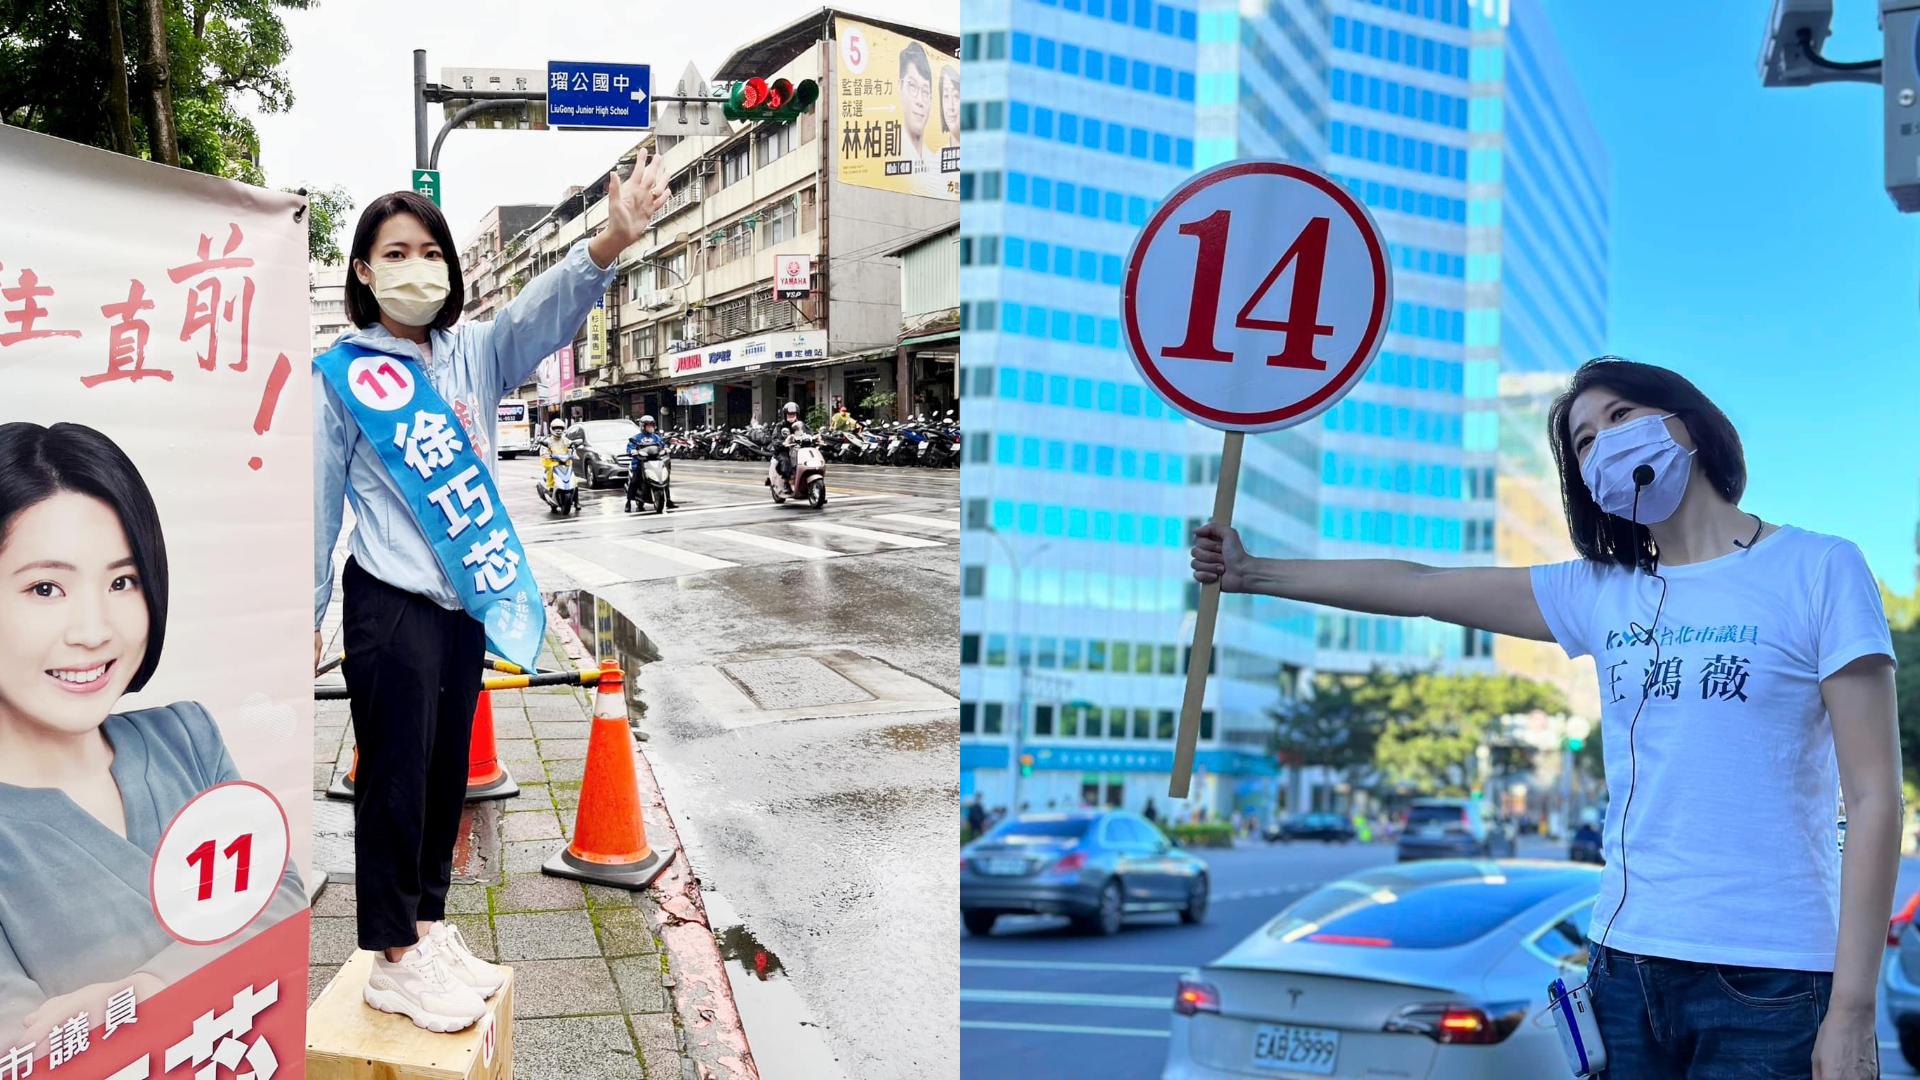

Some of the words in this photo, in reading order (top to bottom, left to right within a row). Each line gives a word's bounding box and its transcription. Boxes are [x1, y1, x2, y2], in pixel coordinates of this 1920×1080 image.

[850, 36, 861, 66] 5
[550, 71, 630, 93] 瑠公國中
[841, 78, 893, 96] 監督最有力
[575, 104, 594, 114] Junior
[595, 105, 609, 117] High
[609, 106, 629, 115] School
[841, 99, 863, 117] 就選
[781, 277, 807, 286] YAMAHA
[1160, 209, 1334, 371] 14
[677, 353, 702, 371] YAMAHA
[356, 361, 409, 400] 11
[393, 408, 521, 593] 徐巧芯
[1660, 624, 1758, 646] 台北市議員
[1606, 654, 1751, 704] 王鴻薇
[185, 832, 253, 902] 11
[0, 984, 139, 1080] 市議員
